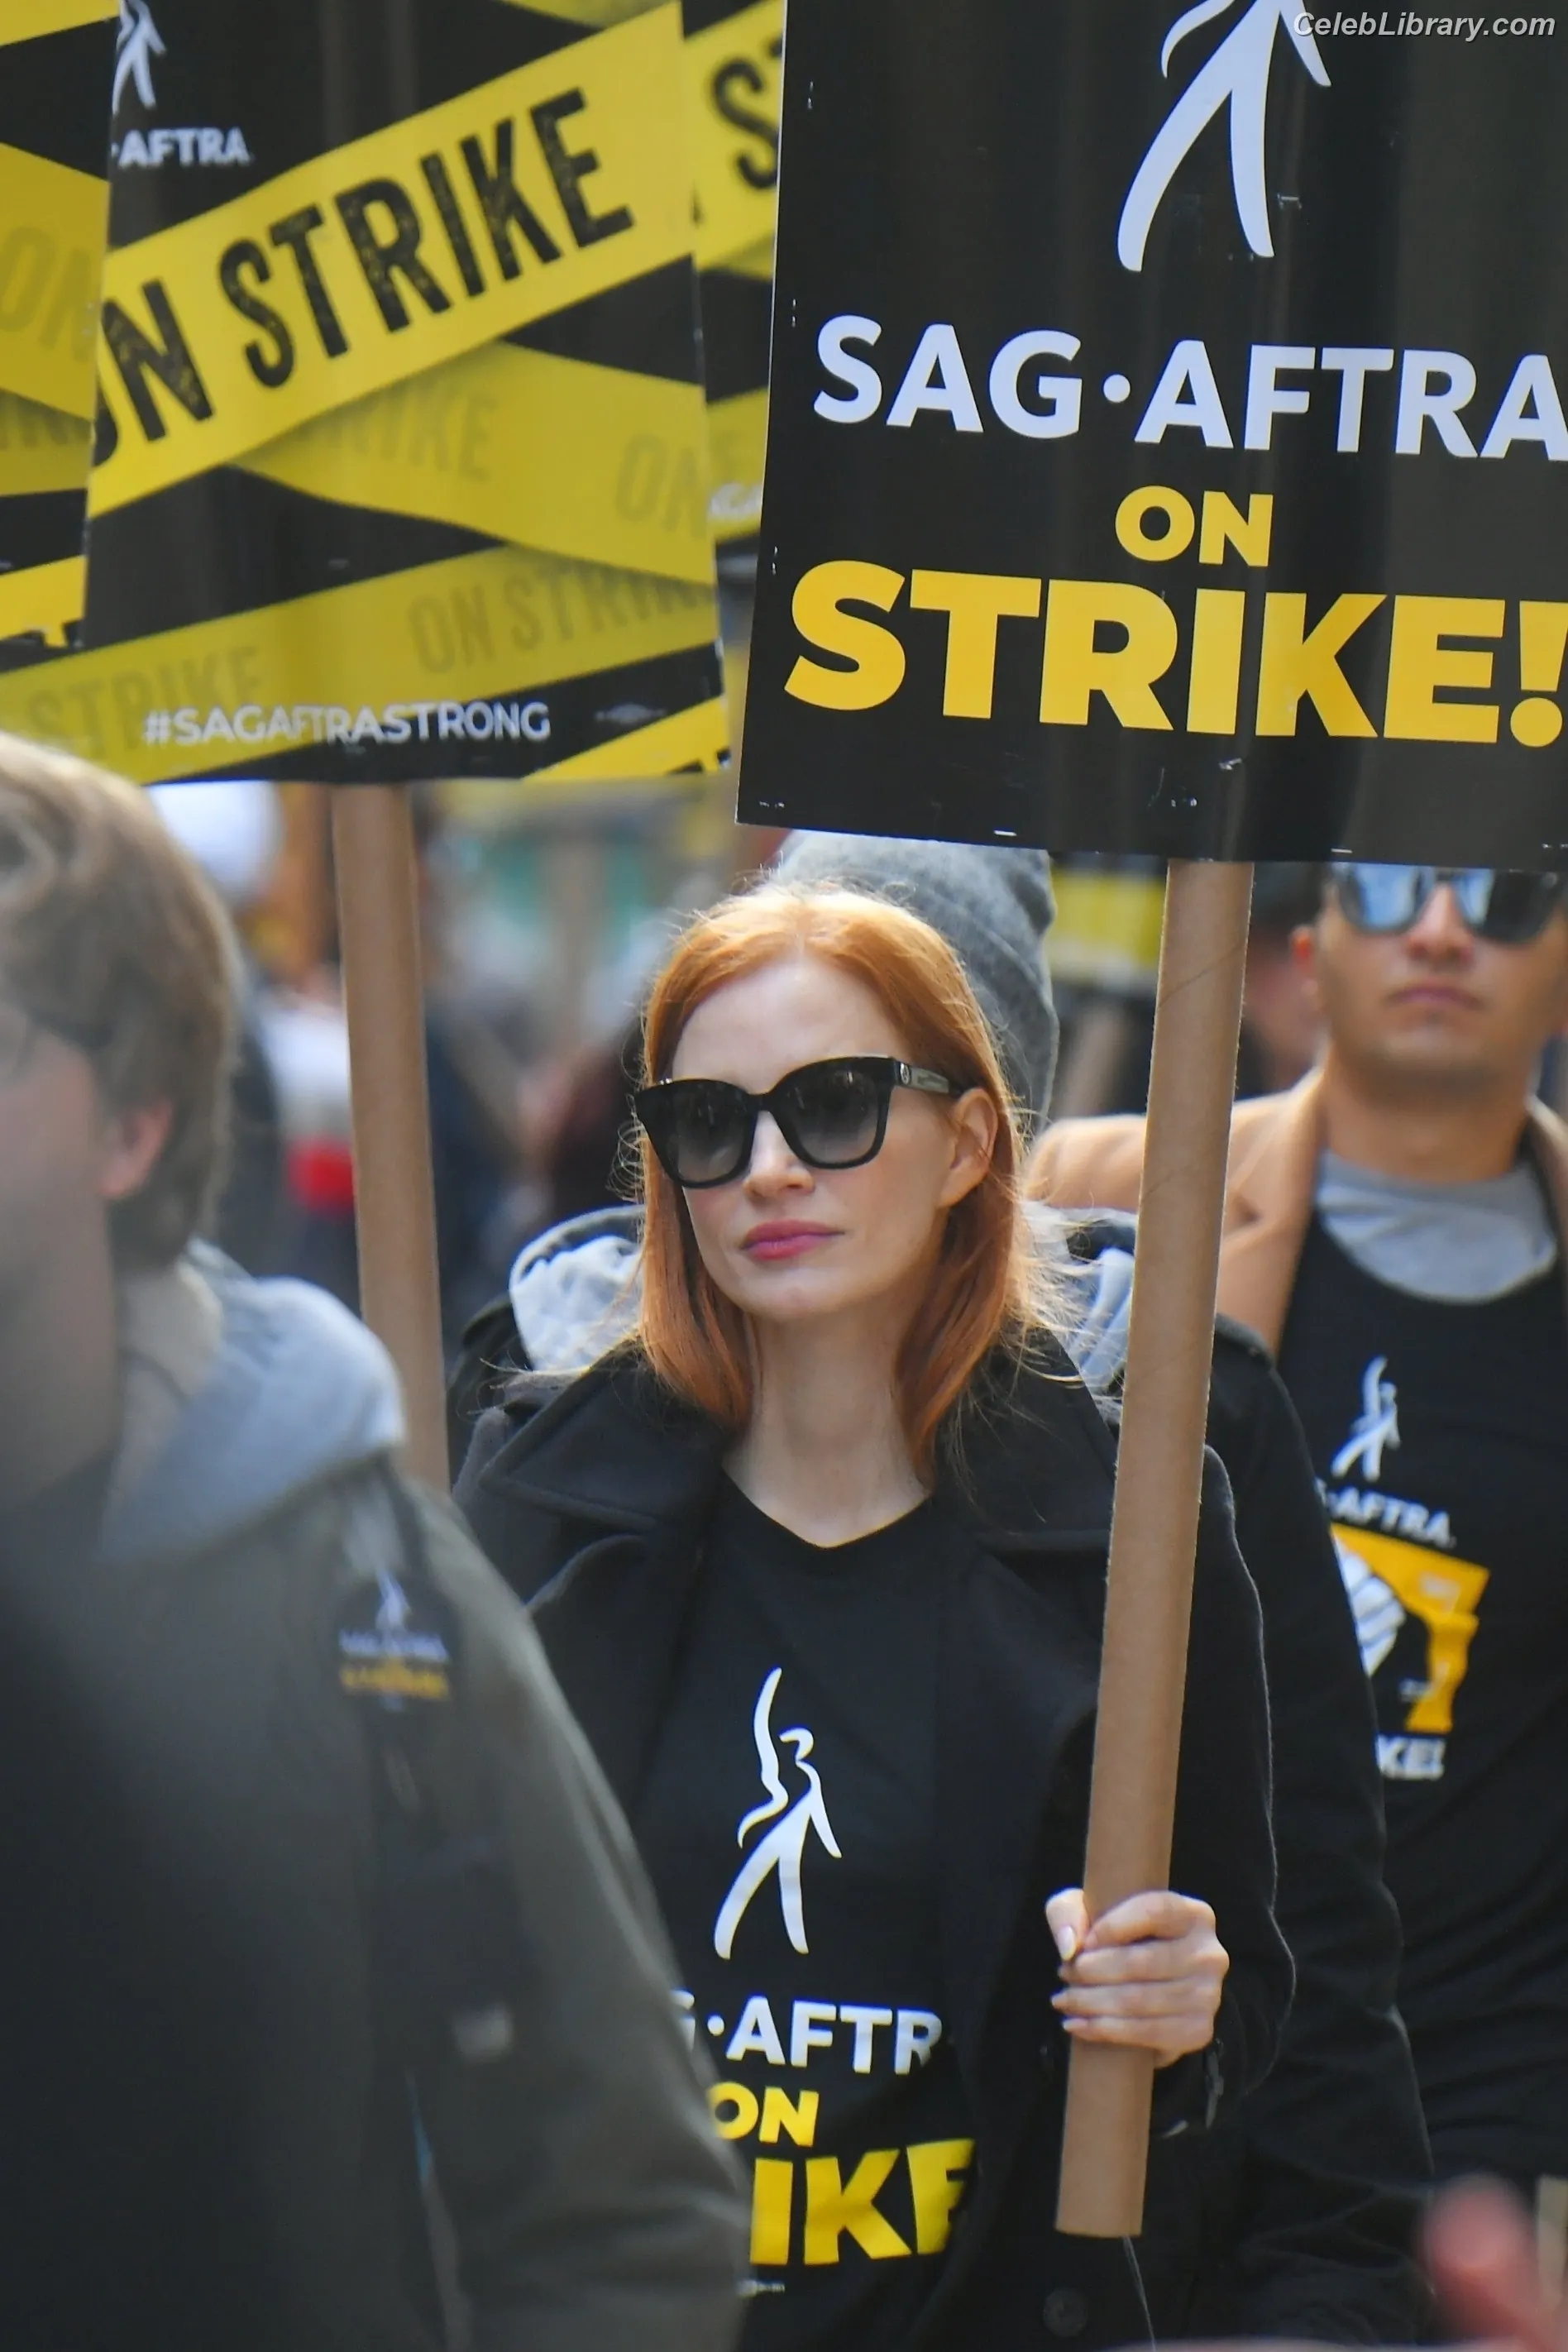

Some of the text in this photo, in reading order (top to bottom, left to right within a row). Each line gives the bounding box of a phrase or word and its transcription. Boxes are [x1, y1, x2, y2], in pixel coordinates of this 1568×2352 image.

[218, 86, 636, 389] STRIKE
[1115, 485, 1274, 567] ON
[784, 560, 1568, 748] STRIKE!
[143, 701, 551, 746] #SAGAFTRASTRONG
[707, 2082, 819, 2147] ON
